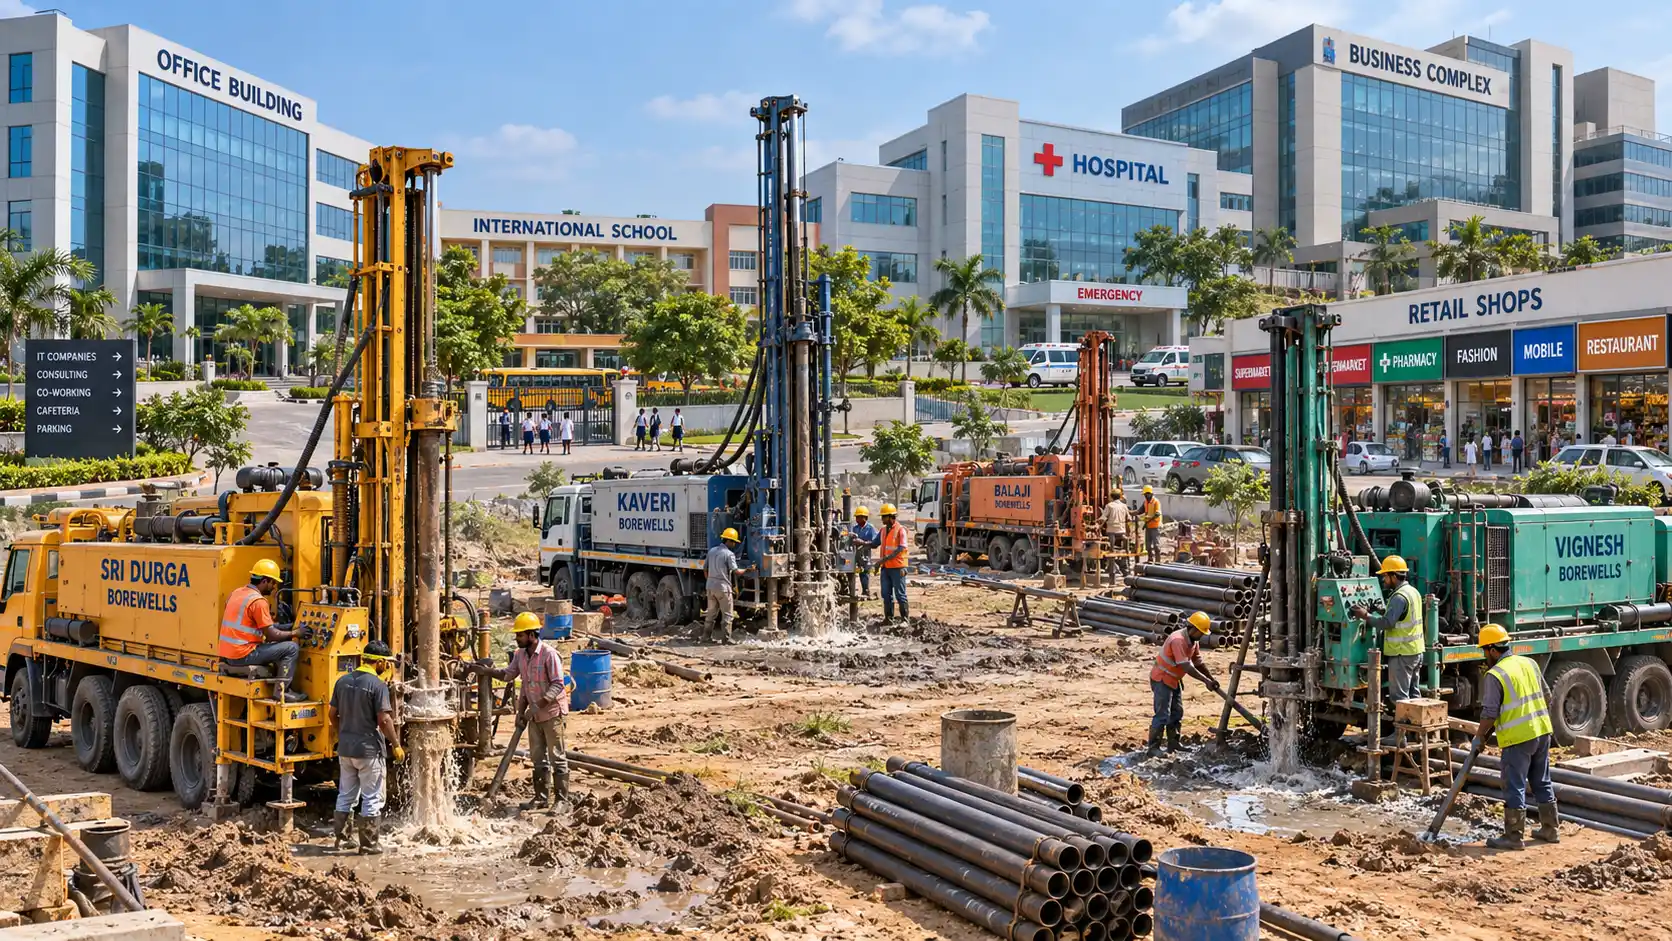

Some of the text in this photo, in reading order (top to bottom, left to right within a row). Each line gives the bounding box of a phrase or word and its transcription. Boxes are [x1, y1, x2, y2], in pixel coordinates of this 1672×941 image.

[1350, 43, 1492, 96] BUSINESS COMPLEX
[157, 49, 302, 121] OFFICE BUILDING
[1073, 153, 1170, 185] HOSPITAL
[473, 217, 677, 241] INTERNATIONAL SCHOOL
[1077, 287, 1143, 302] EMERGENCY
[1409, 287, 1543, 325] RETAIL SHOPS
[1523, 342, 1563, 359] MOBILE
[1587, 334, 1659, 355] RESTAURANT
[36, 352, 97, 361] IT COMPANIES
[1393, 352, 1437, 368] PHARMACY
[1457, 347, 1498, 363] FASHION
[36, 370, 88, 379] CONSULTING
[36, 388, 92, 397] CO-WORKING
[36, 406, 80, 415] CAFETERIA
[36, 424, 72, 433] PARKING
[994, 484, 1030, 497] BALAJI
[617, 492, 675, 512] KAVERI
[619, 517, 674, 532] BOREWELLS
[1555, 534, 1624, 558] VIGNESH
[101, 558, 190, 588] SRI DURGA
[1559, 563, 1621, 581] BOREWELLS
[107, 588, 177, 613] BOREWELLS
